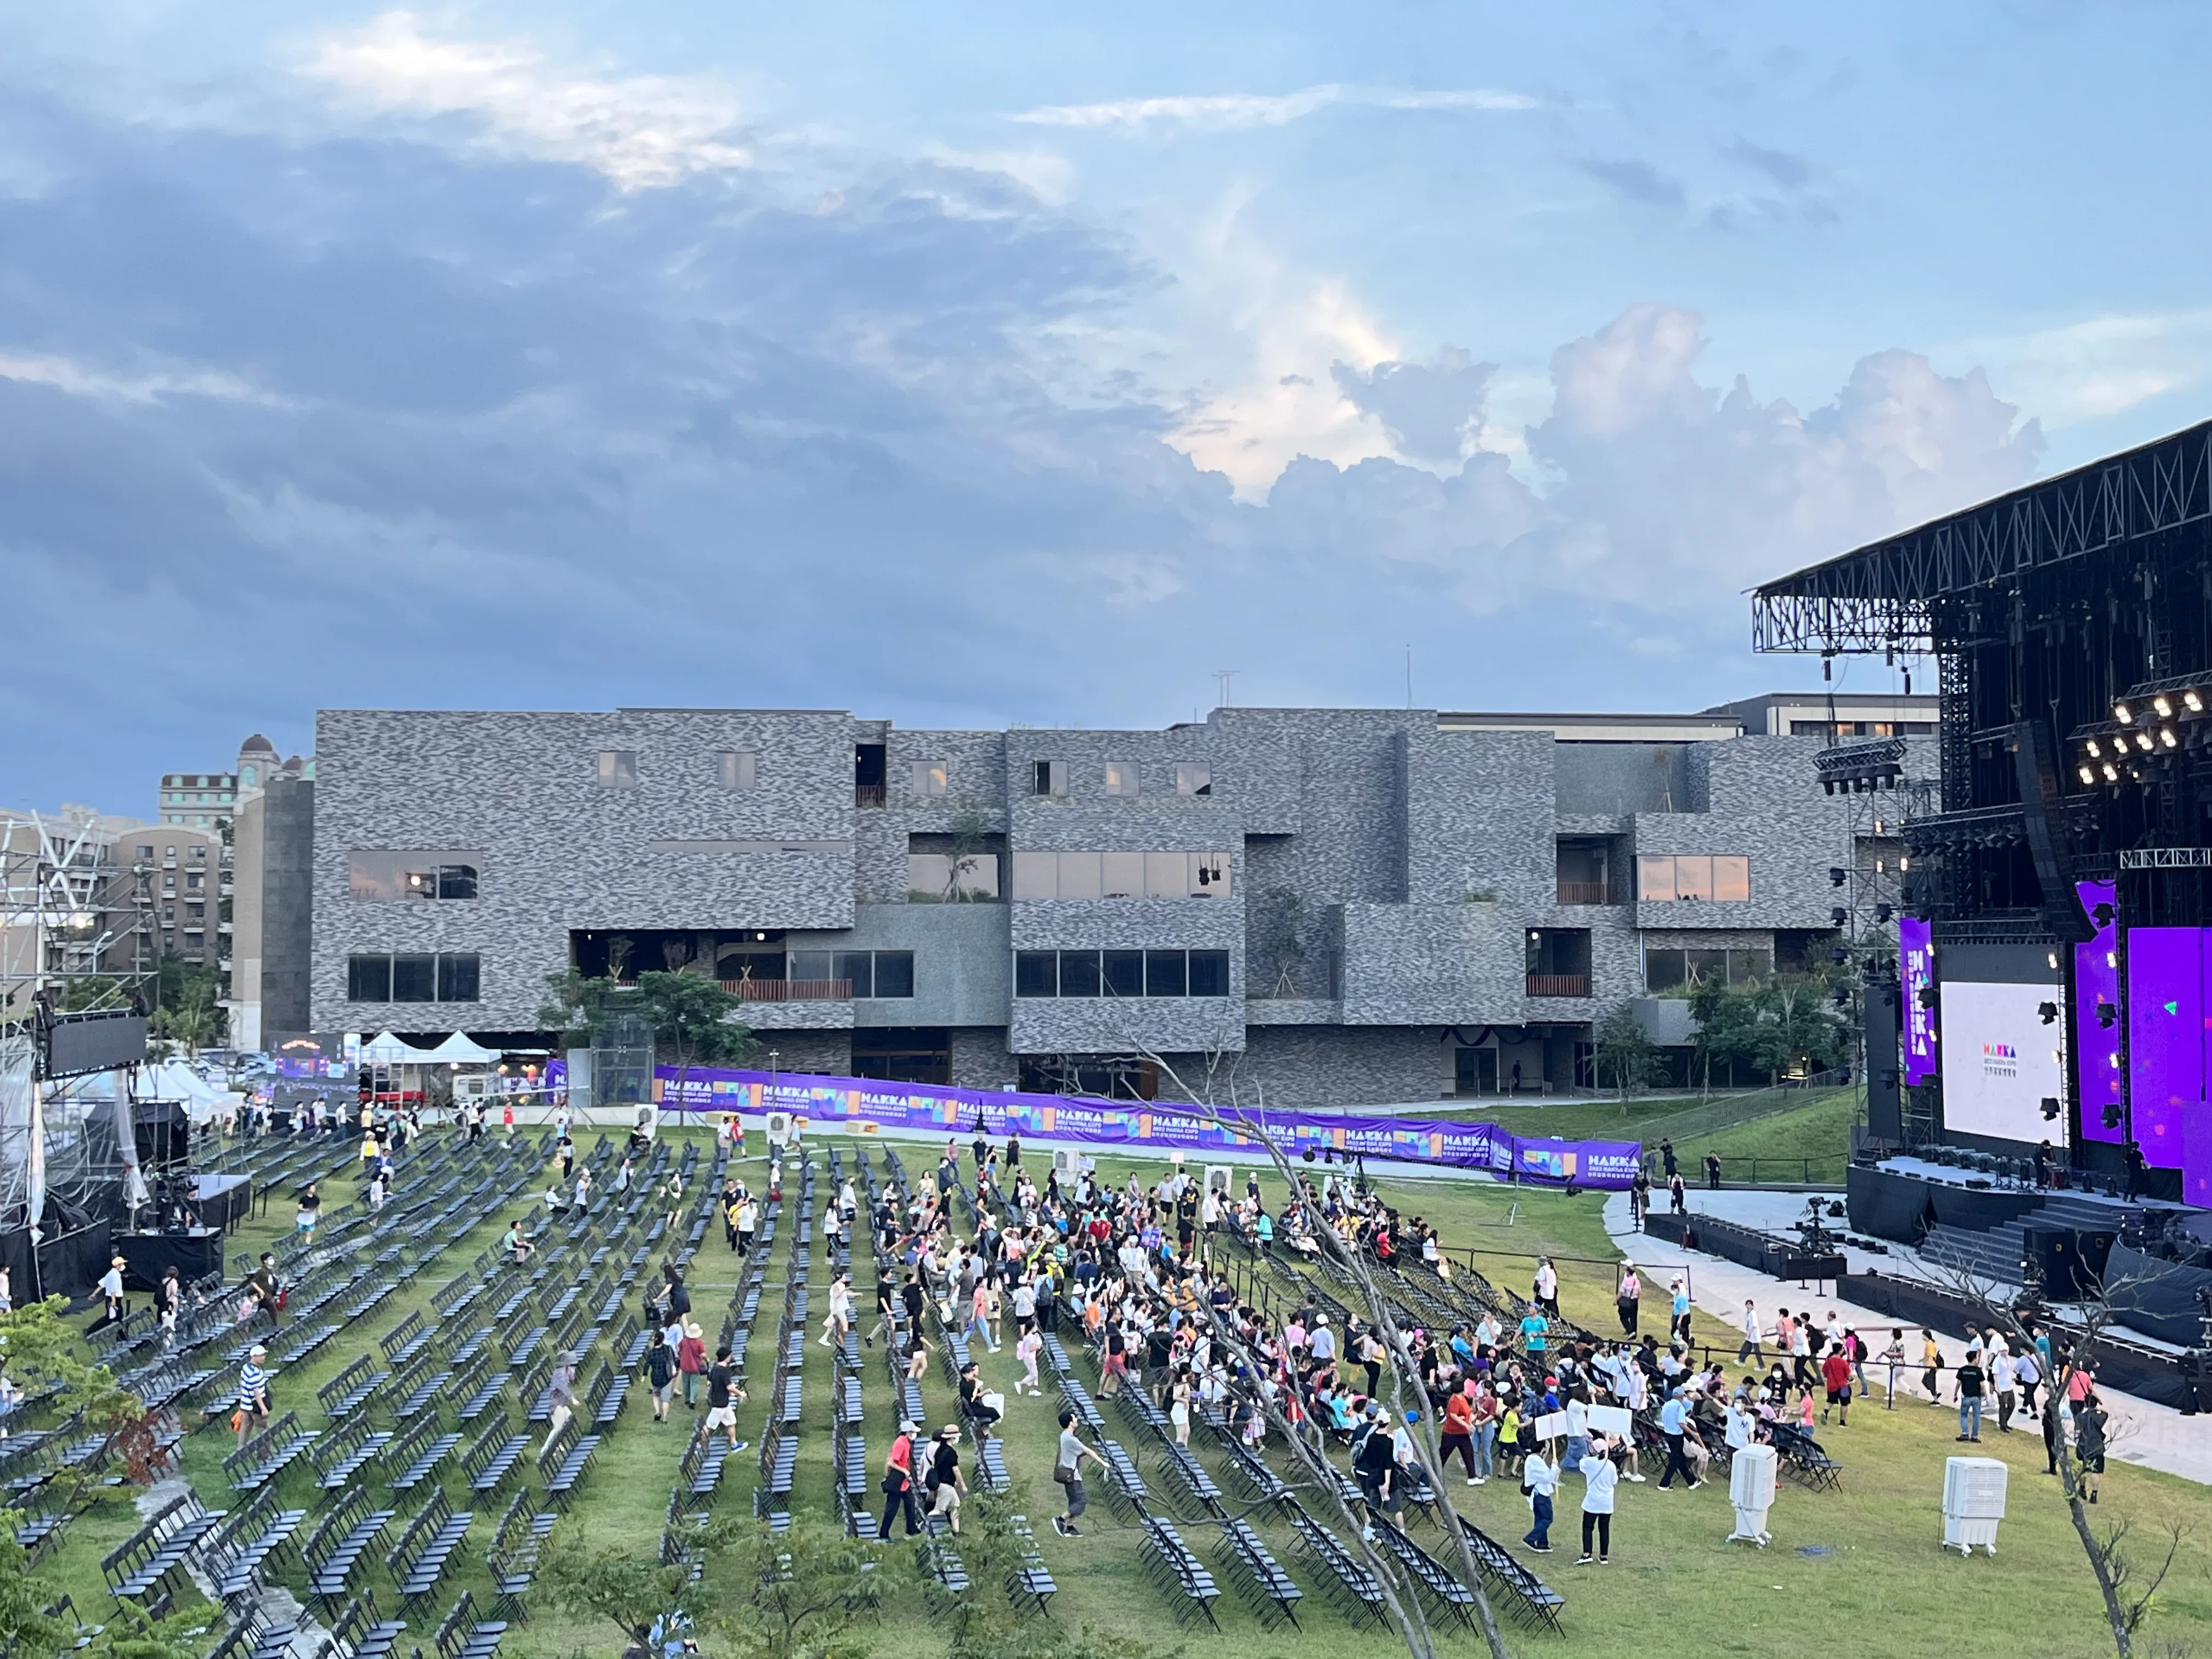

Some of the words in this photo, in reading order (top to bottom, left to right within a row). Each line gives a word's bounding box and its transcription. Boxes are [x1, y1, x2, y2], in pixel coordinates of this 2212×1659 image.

[1983, 1043, 2016, 1058] HAKKA
[763, 1085, 810, 1098] HAKKA
[861, 1092, 907, 1106] HAKKA
[958, 1102, 1006, 1115] HAKKA
[1056, 1108, 1102, 1122] HAKKA
[1153, 1116, 1199, 1128] HAKKA
[1346, 1129, 1392, 1141] HAKKA
[1443, 1135, 1489, 1146] HAKKA
[1589, 1155, 1640, 1167] HAKKA
